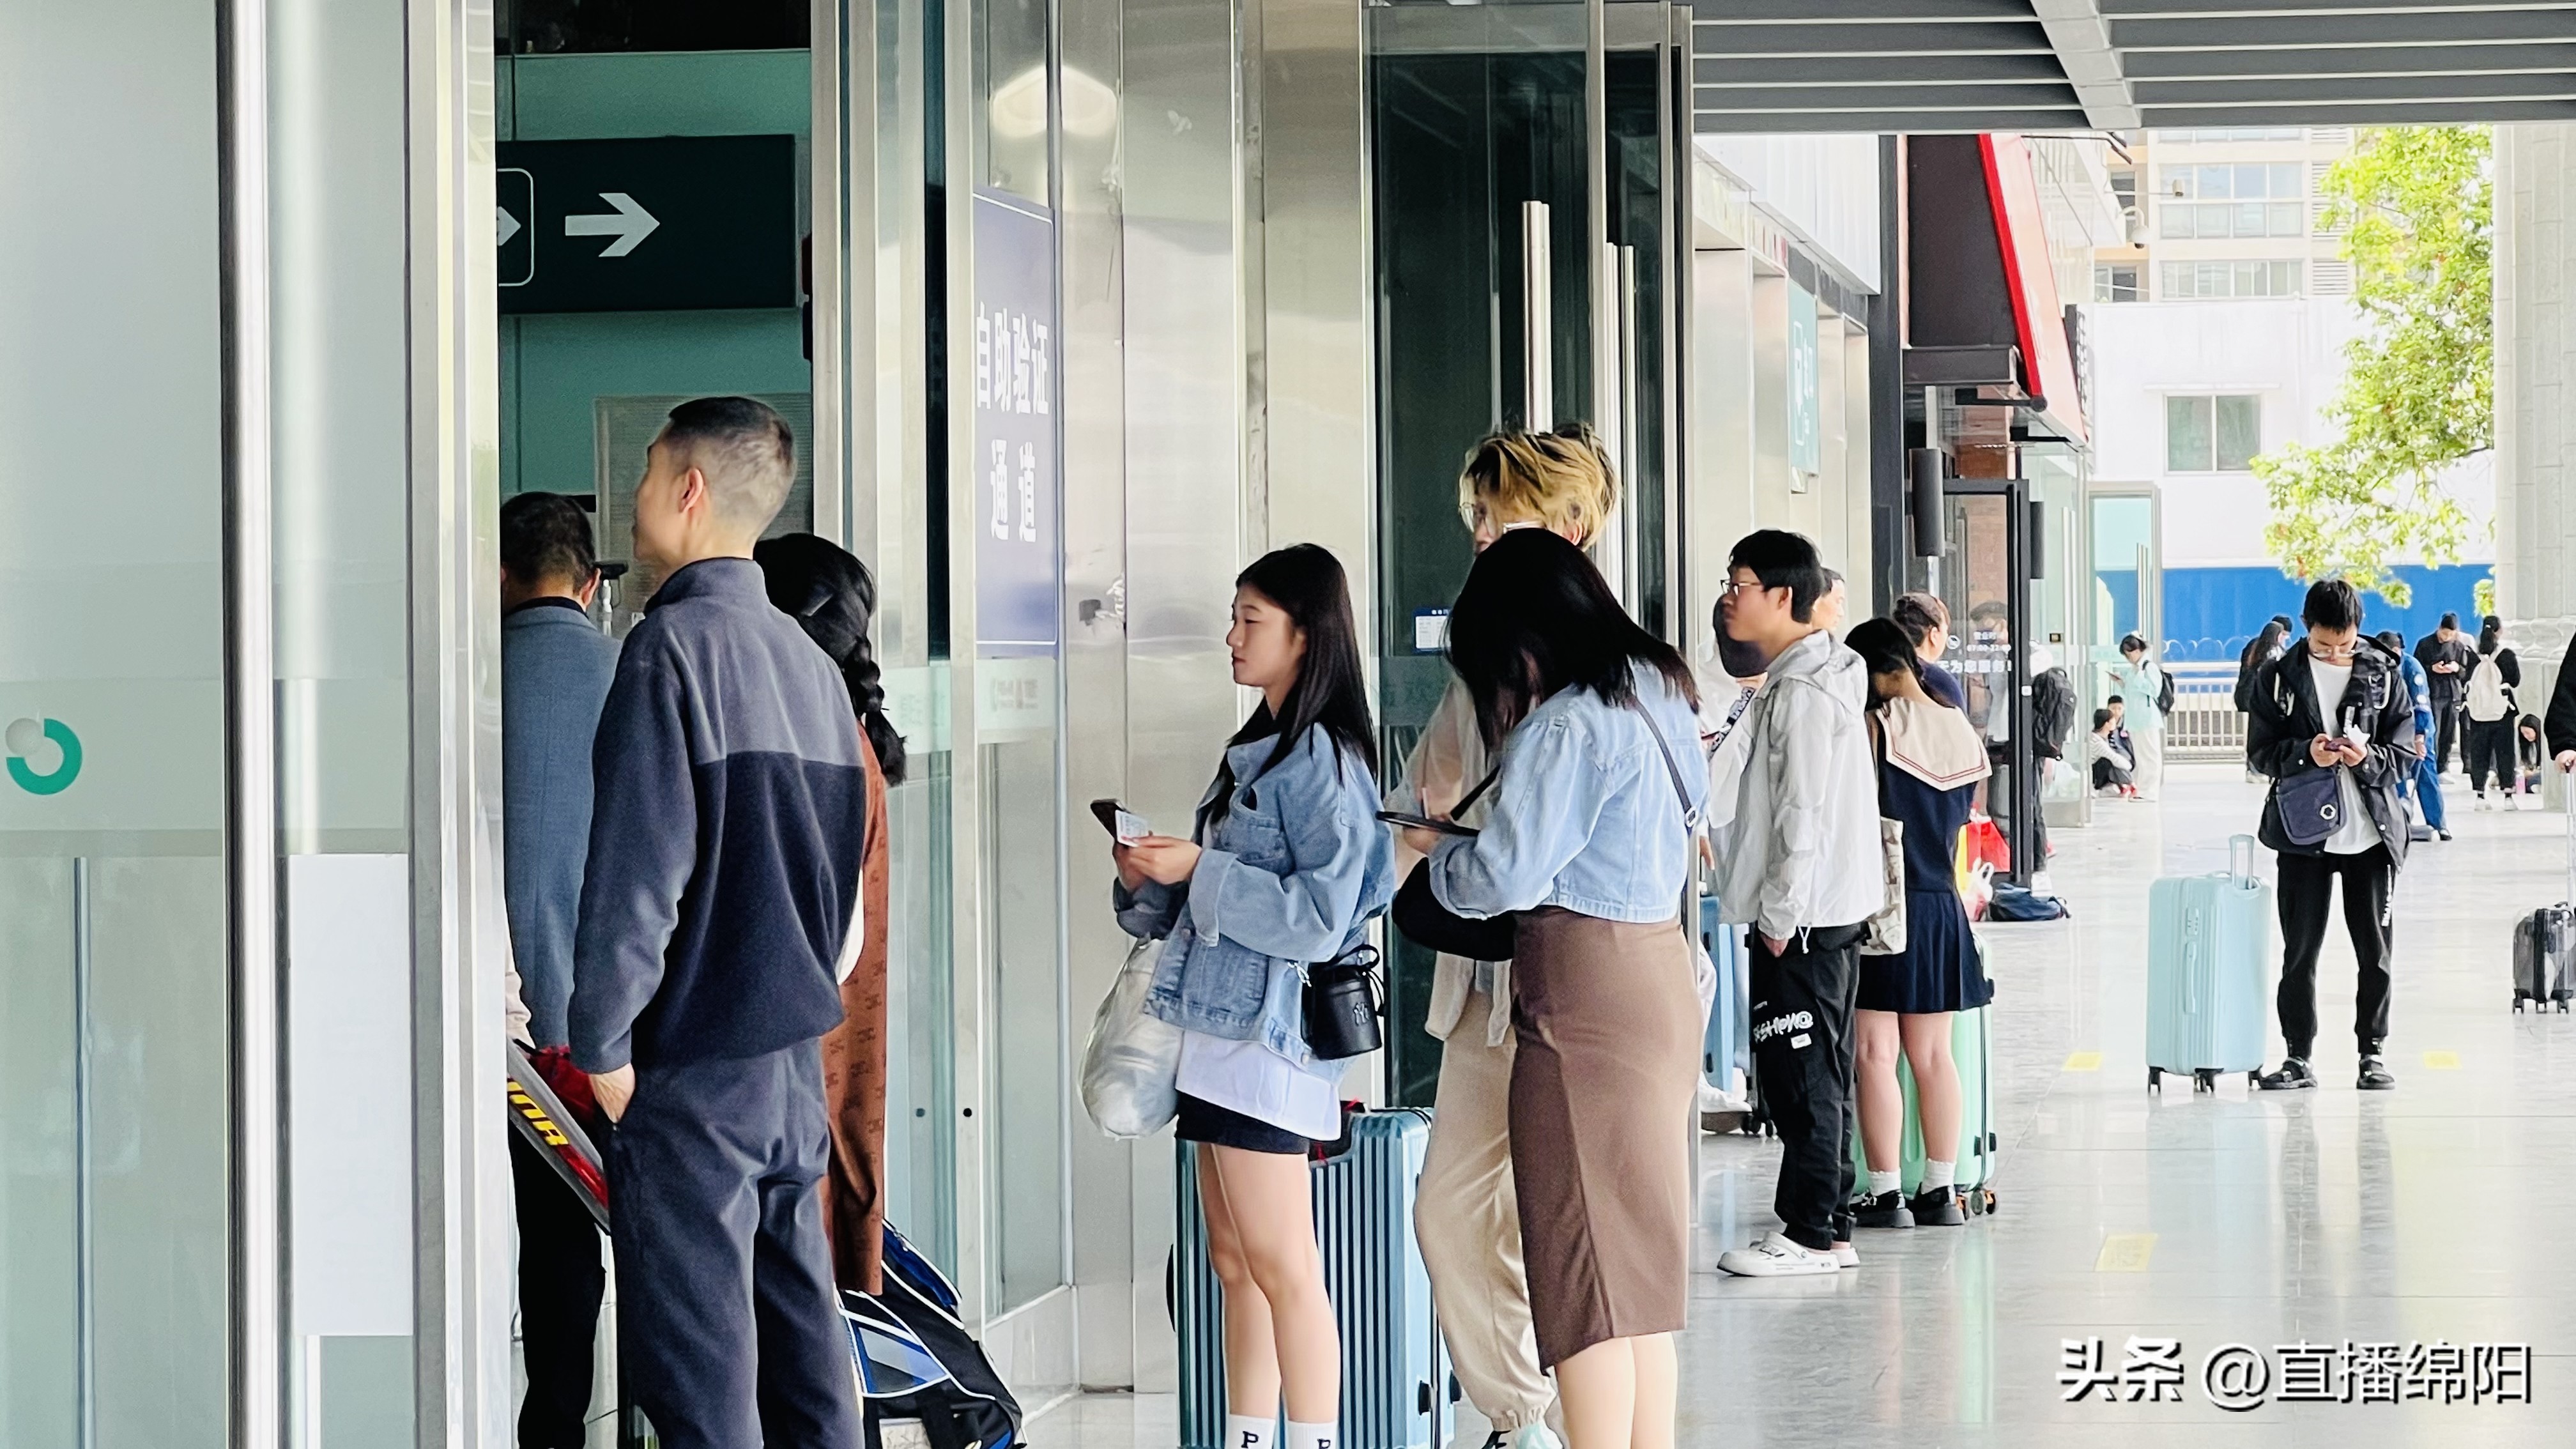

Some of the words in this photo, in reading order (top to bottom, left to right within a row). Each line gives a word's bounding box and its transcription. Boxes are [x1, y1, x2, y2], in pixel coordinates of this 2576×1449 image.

[977, 301, 1048, 415] 自助验证
[990, 439, 1036, 542] 通道
[1241, 1430, 1259, 1448] P
